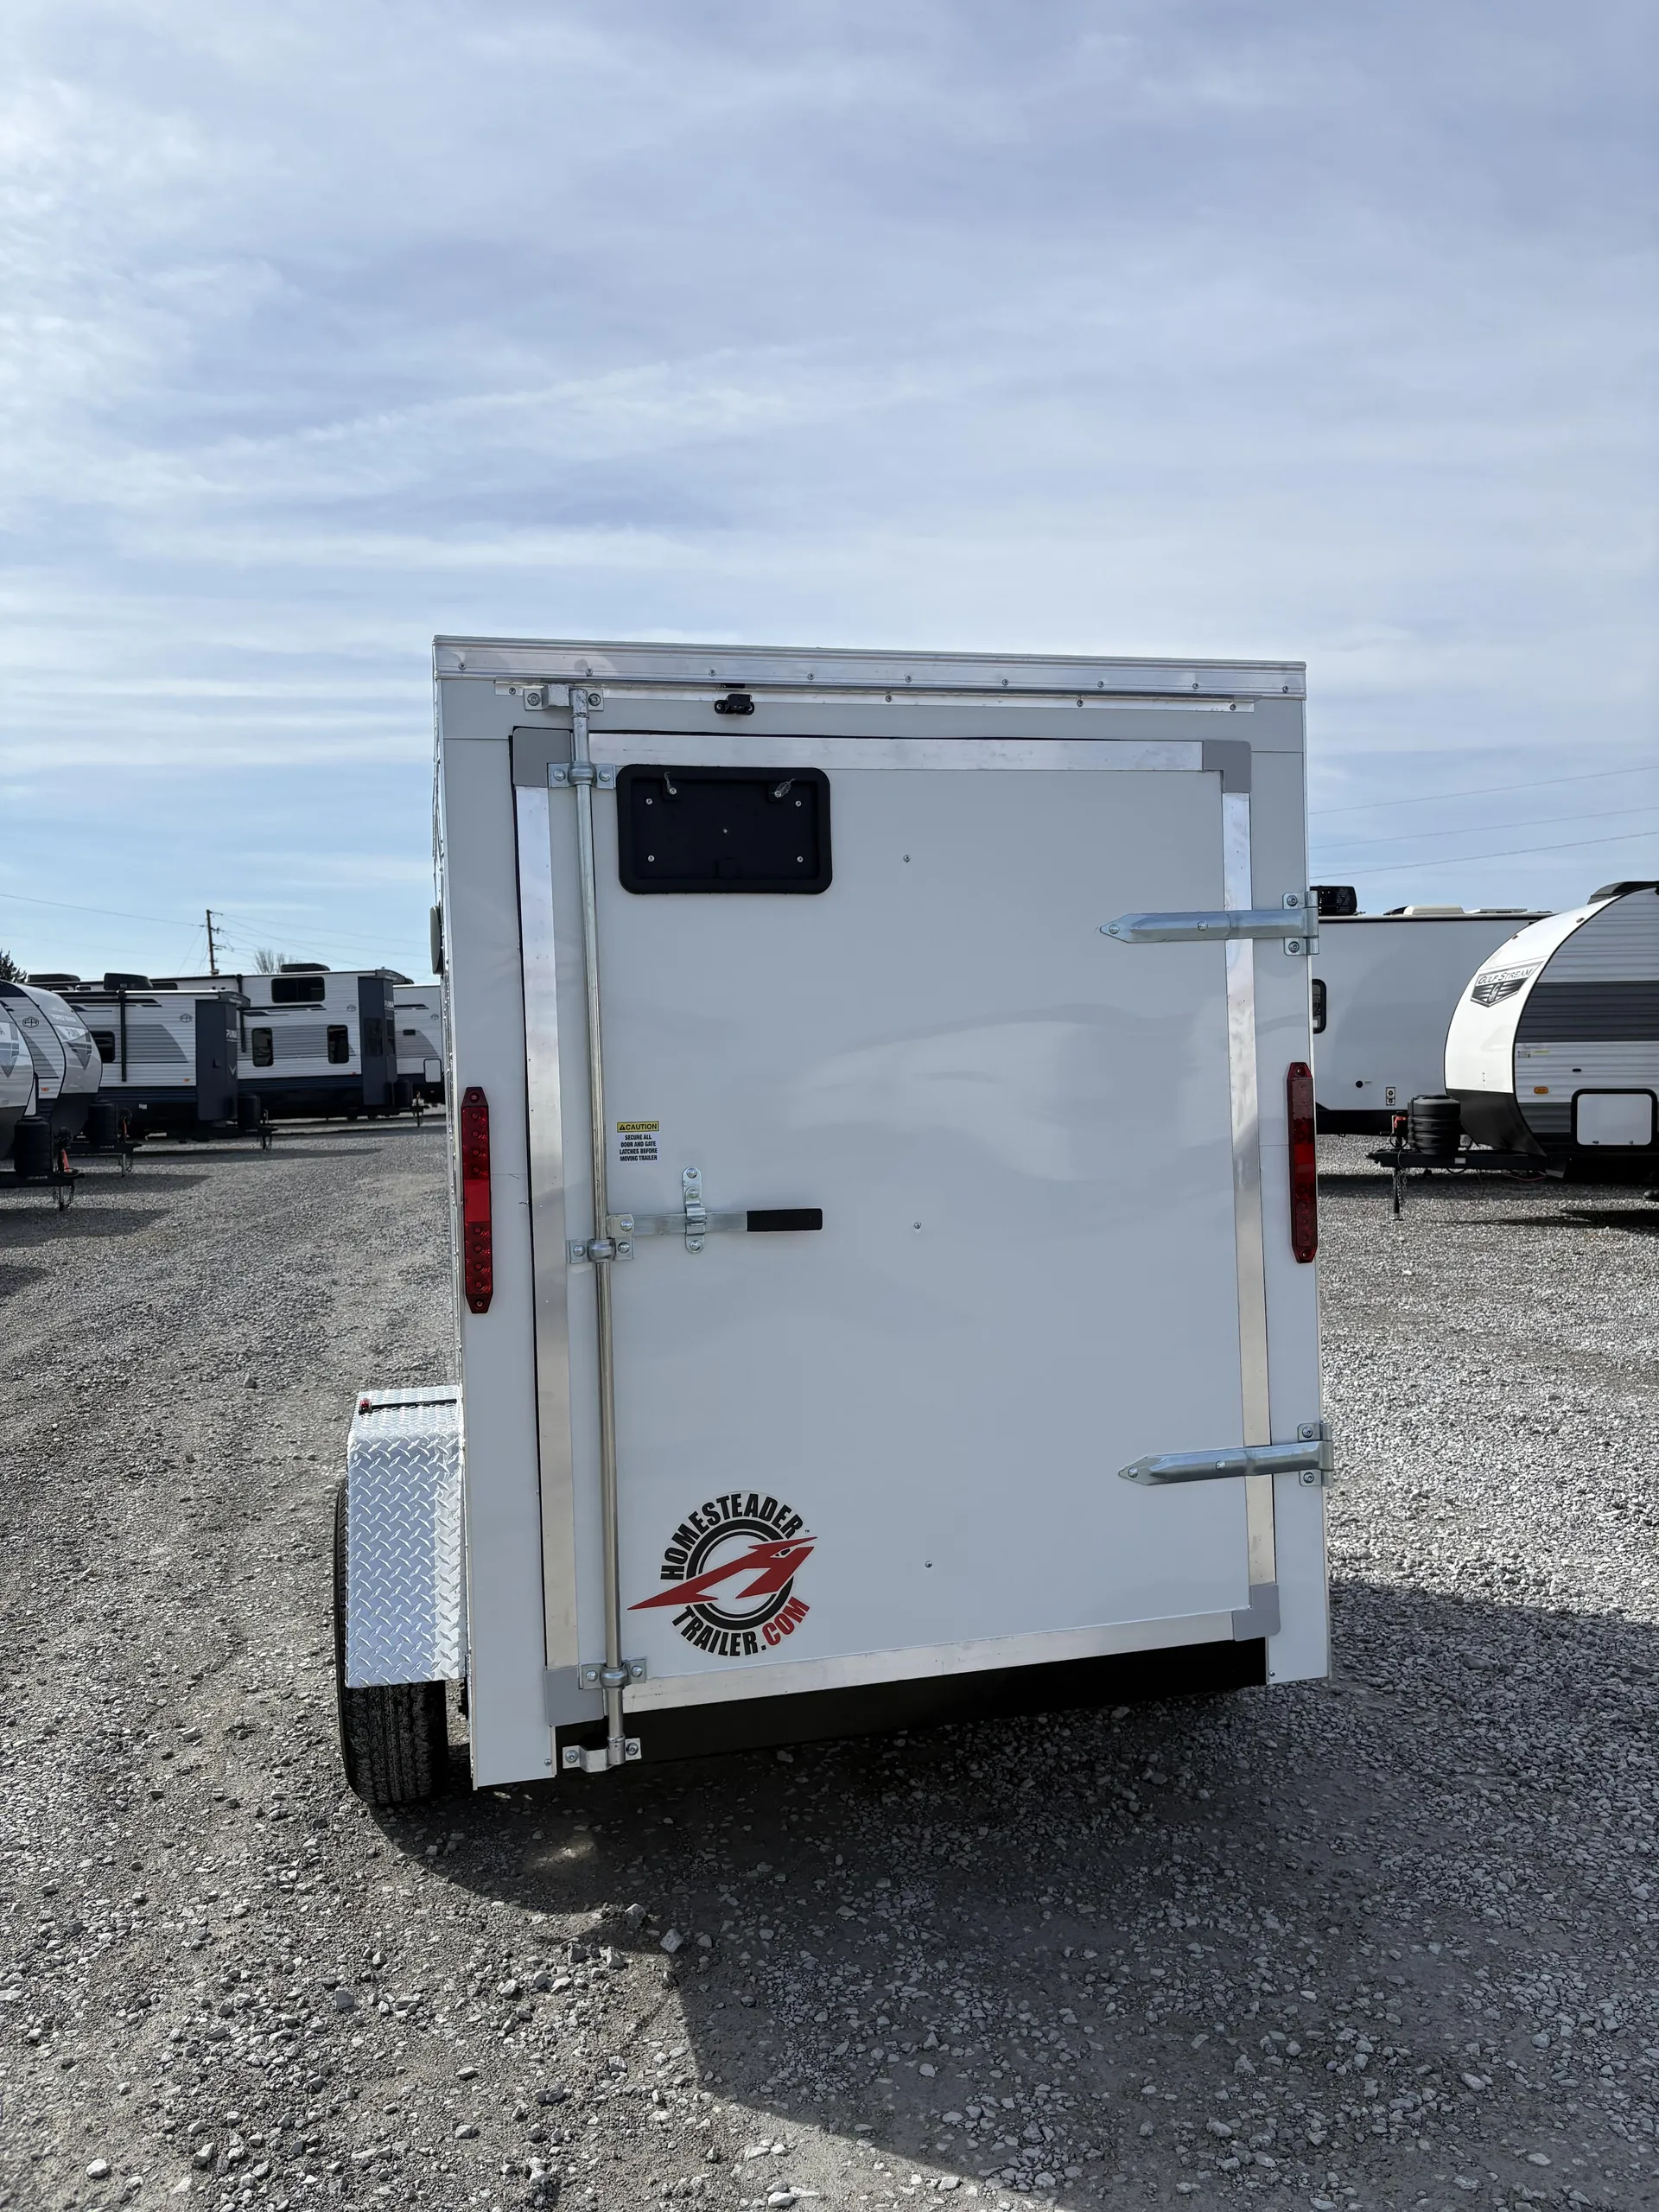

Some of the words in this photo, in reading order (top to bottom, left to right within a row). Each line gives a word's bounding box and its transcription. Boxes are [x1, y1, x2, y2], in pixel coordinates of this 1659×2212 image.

[1498, 968, 1533, 981] STREAM
[659, 1493, 804, 1580] HOMESTEADER
[671, 1596, 810, 1656] TRAILER.COM
